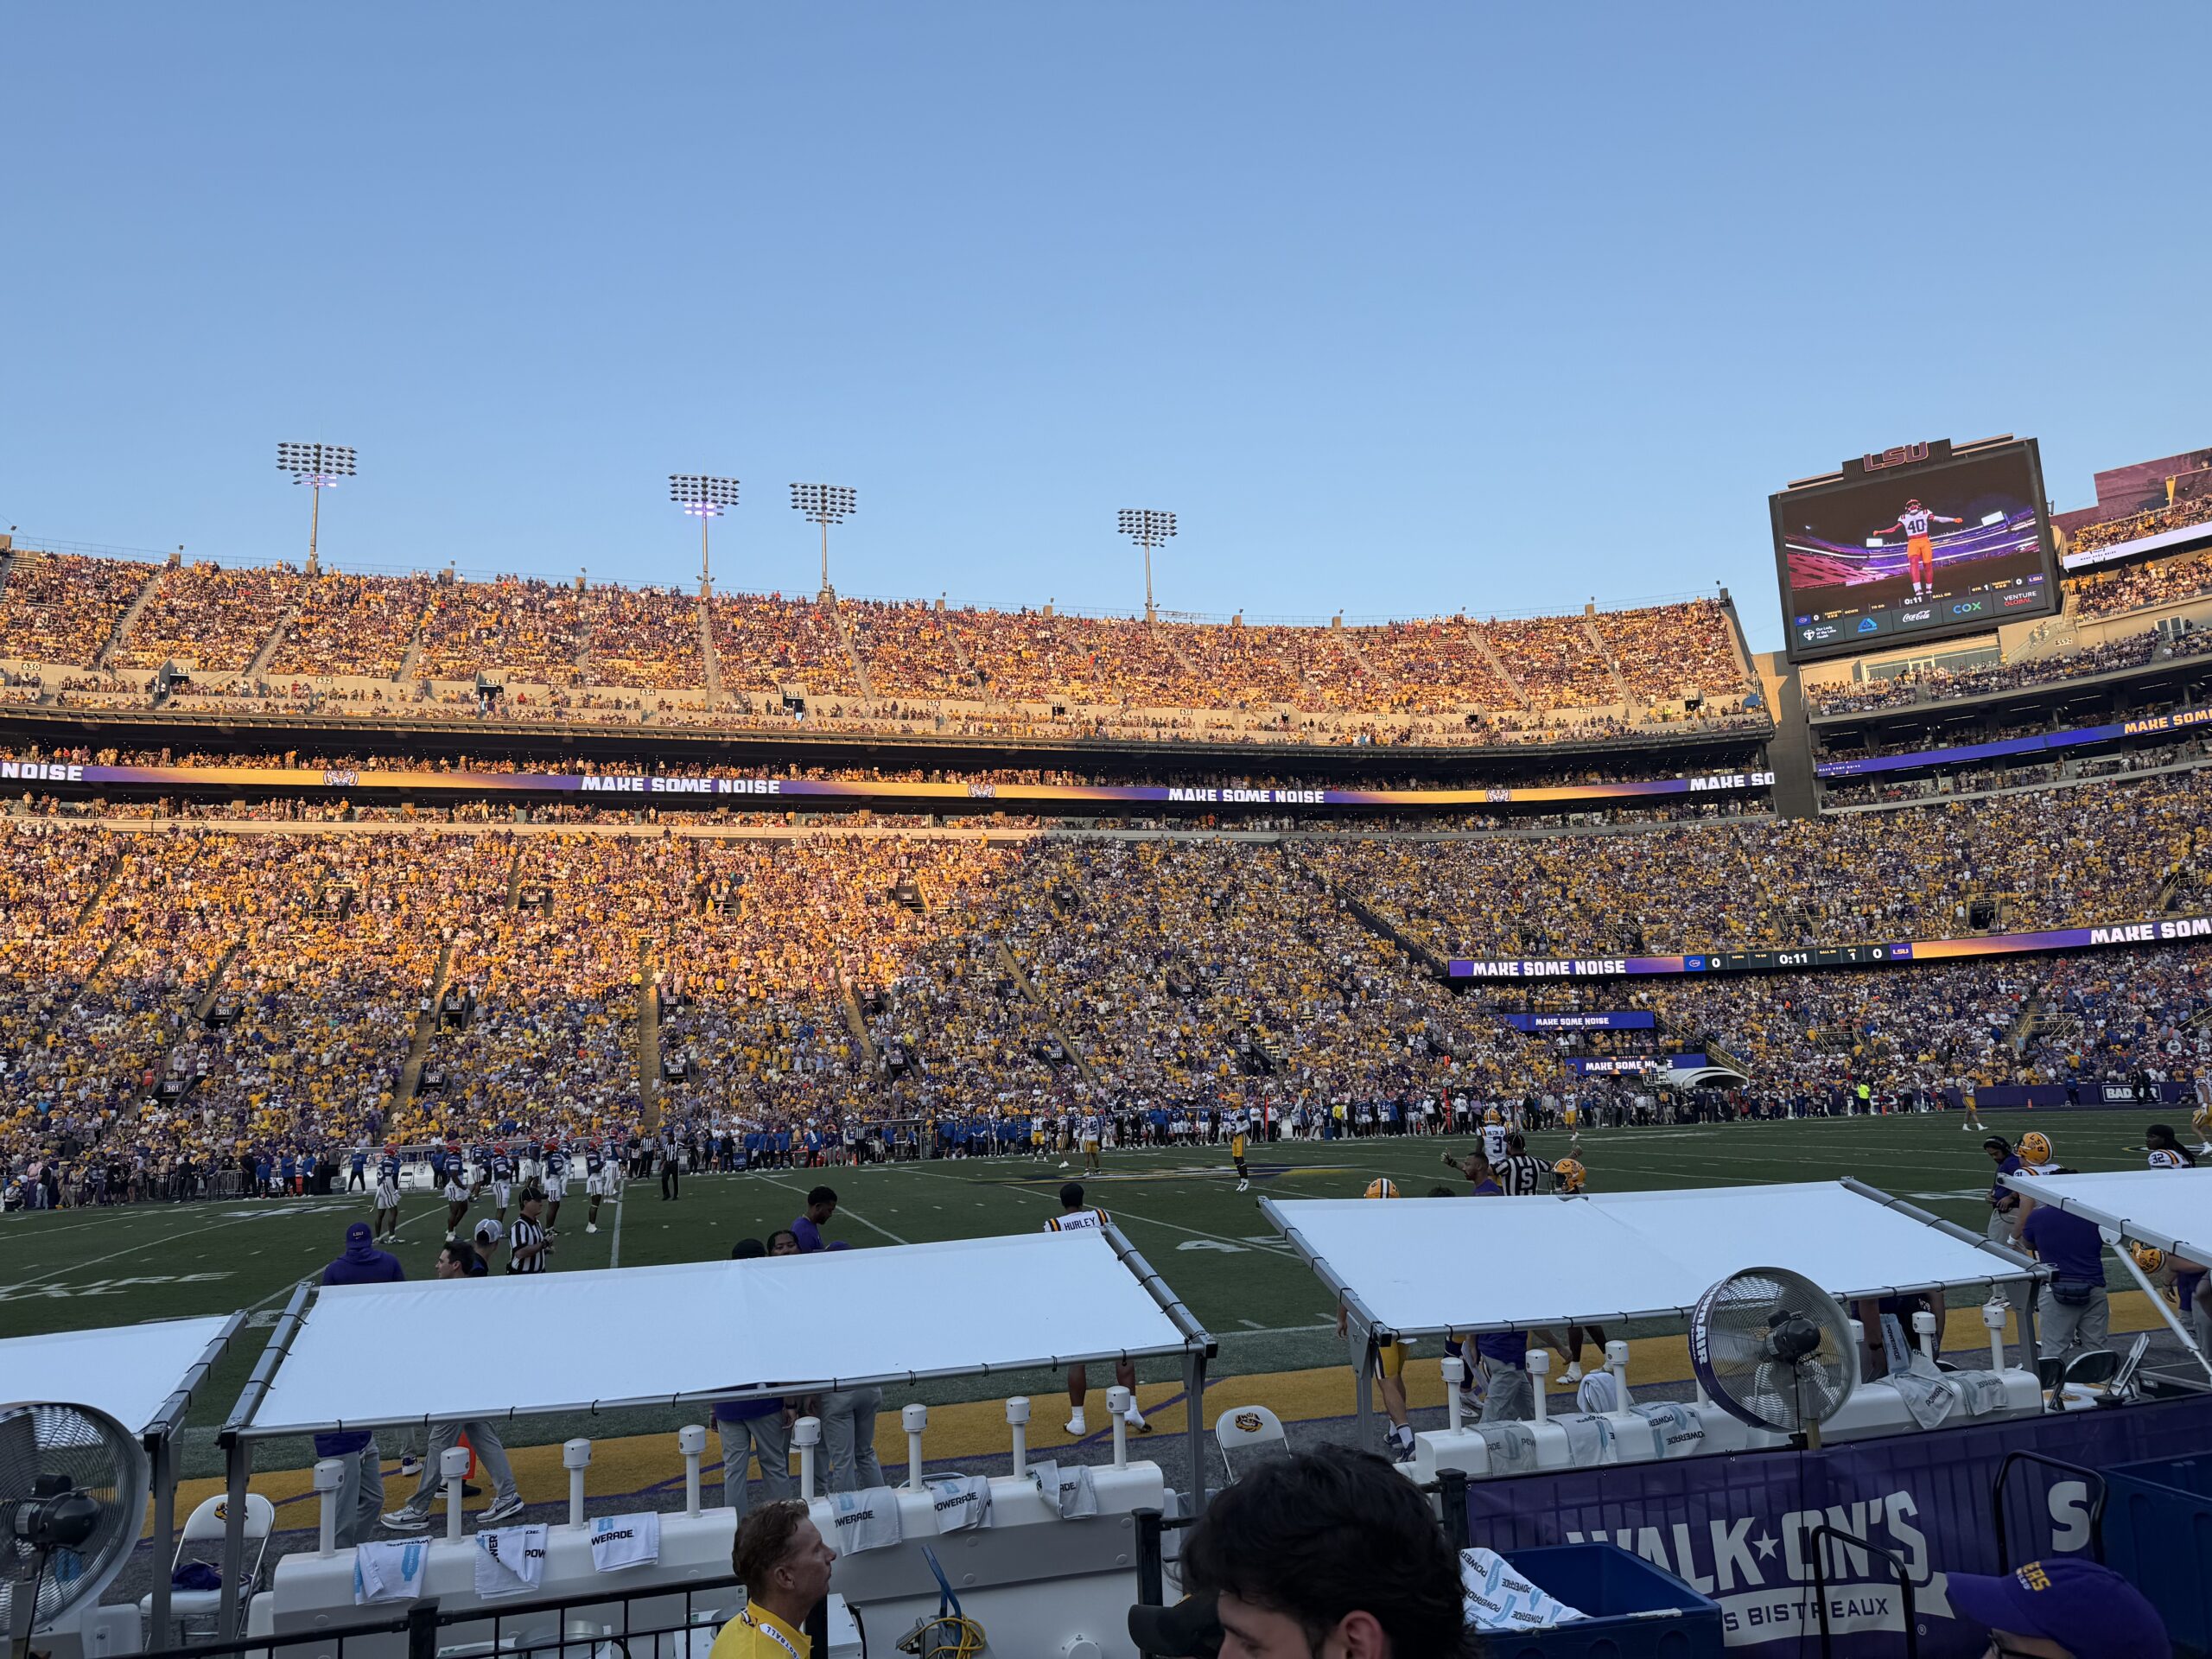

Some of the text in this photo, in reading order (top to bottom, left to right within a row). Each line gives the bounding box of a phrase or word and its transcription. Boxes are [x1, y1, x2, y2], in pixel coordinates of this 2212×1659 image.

[1863, 441, 1929, 472] LSU
[1908, 518, 1925, 533] 40
[1904, 596, 1923, 605] 0:11
[2003, 590, 2037, 601] VENTURE
[2004, 598, 2032, 607] GLOBAL
[1953, 601, 1982, 614] COX
[2125, 717, 2169, 734] MAKE
[2, 762, 84, 781] NOISE
[581, 777, 780, 794] MAKE SOME NOISE
[1690, 774, 1745, 791] MAKE
[1168, 788, 1325, 804] MAKE SOME NOISE
[2091, 918, 2212, 944] MAKE SOM
[1779, 953, 1808, 965] 0:11
[1849, 952, 1856, 961] 1
[1872, 948, 1883, 959] 0
[1472, 960, 1626, 976] MAKE SOME NOISE
[1711, 957, 1721, 968] 0
[1560, 1017, 1584, 1026] SOME
[1586, 1059, 1673, 1071] MAKE SOME NOE
[1493, 1135, 1502, 1154] 3
[2151, 1153, 2165, 1165] 32
[1521, 1167, 1534, 1189] S
[1064, 1217, 1096, 1230] HURLEY
[1695, 1325, 1708, 1365] AIR
